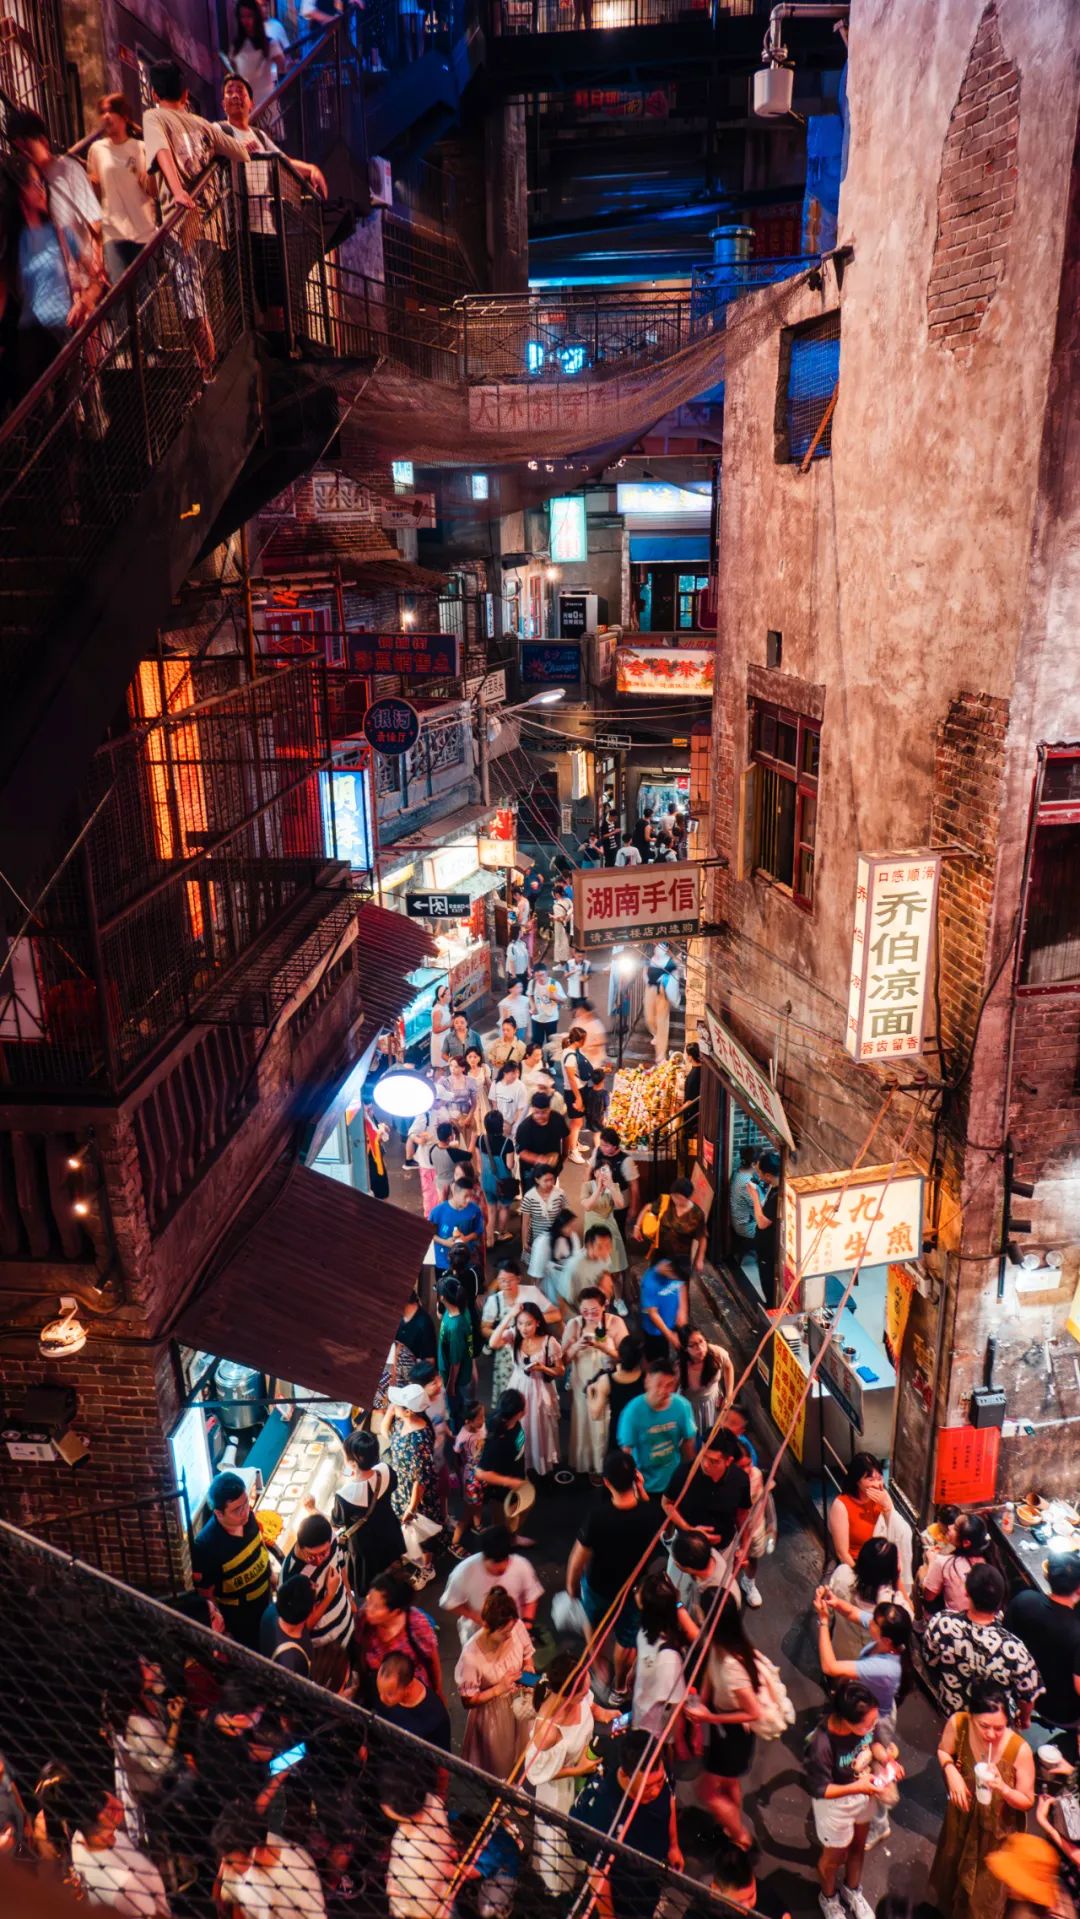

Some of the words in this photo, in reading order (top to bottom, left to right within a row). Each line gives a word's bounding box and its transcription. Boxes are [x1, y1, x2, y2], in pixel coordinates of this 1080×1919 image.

[371, 708, 411, 730] 银河
[878, 865, 936, 883] 口感顺滑
[586, 877, 696, 920] 湖南手信
[590, 922, 694, 944] 请至二楼店内选购
[867, 890, 928, 1039] 乔伯凉面
[861, 1036, 920, 1056] 唇齿留香
